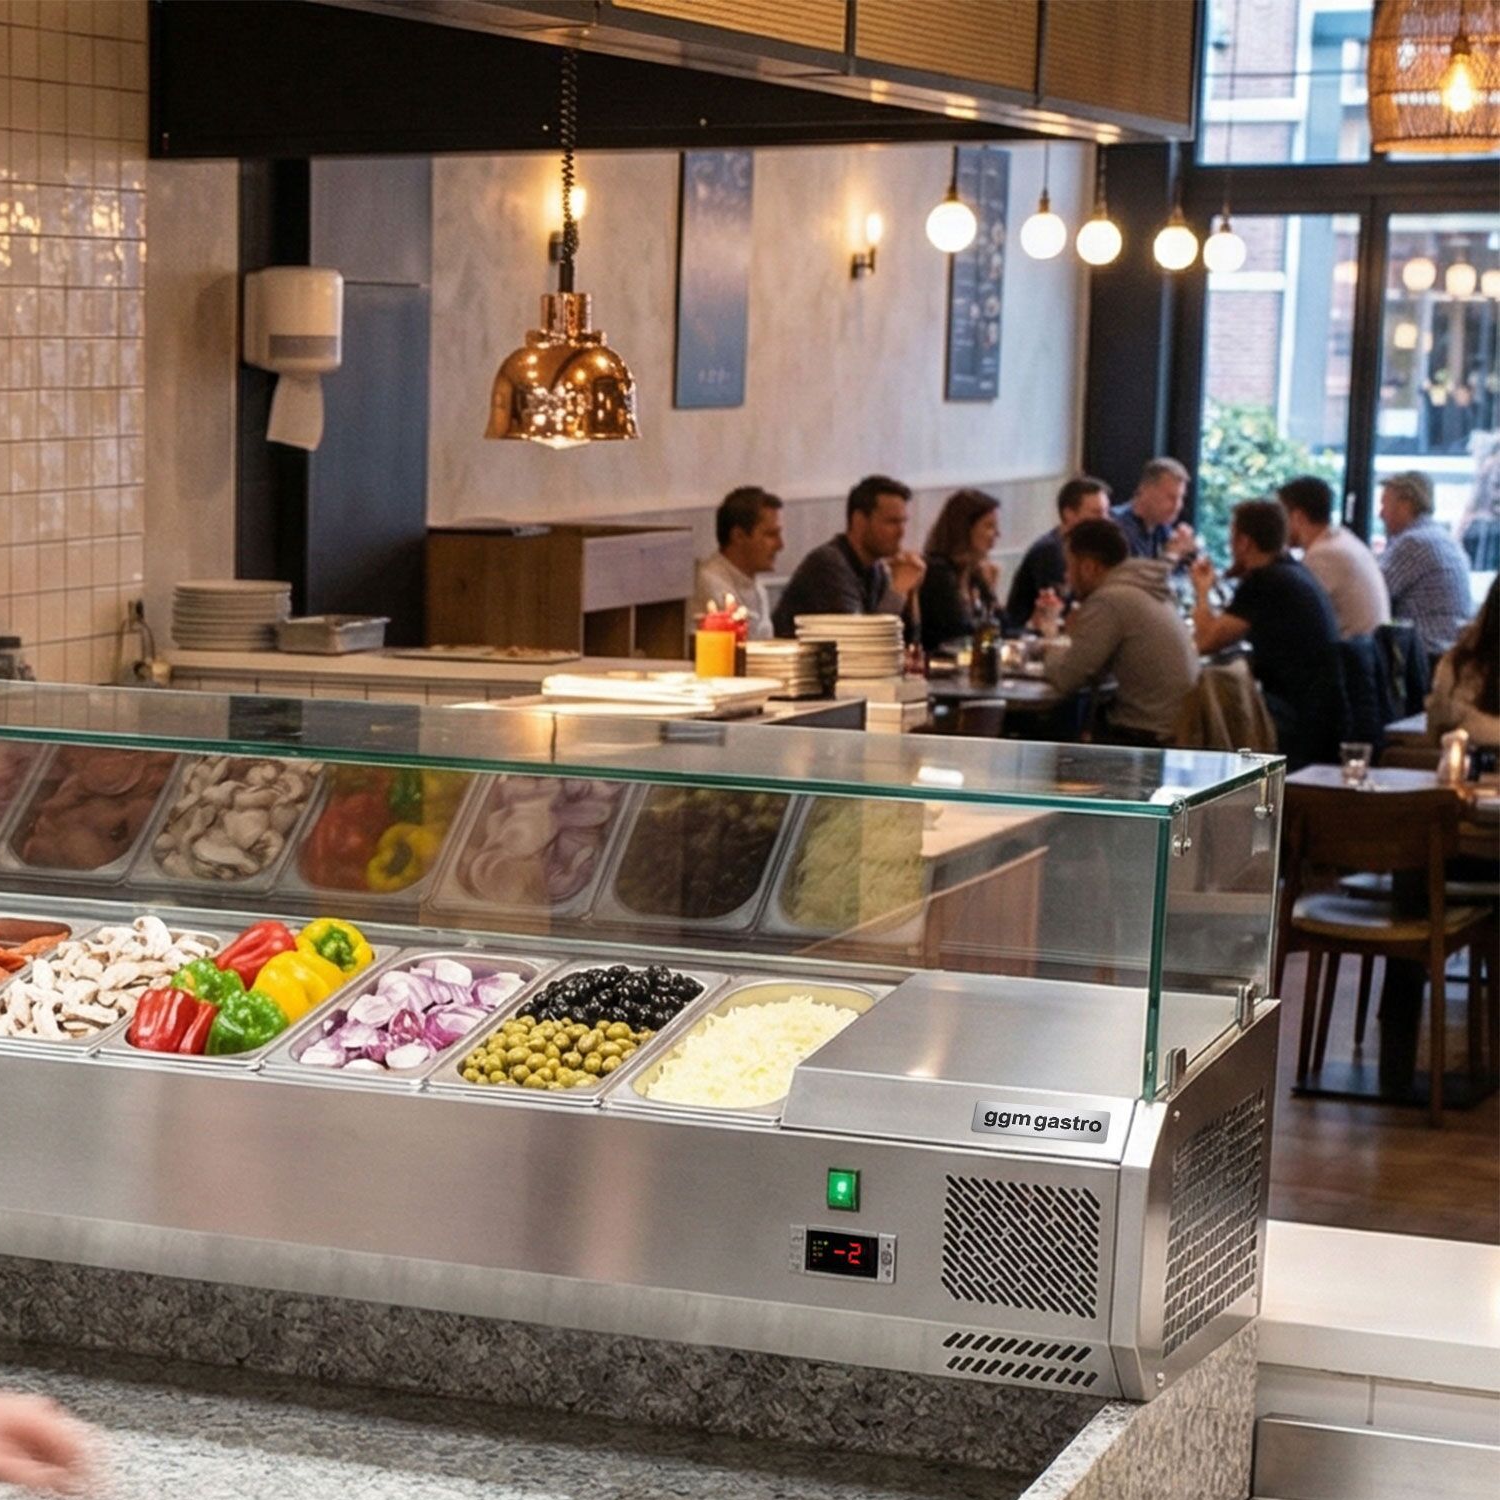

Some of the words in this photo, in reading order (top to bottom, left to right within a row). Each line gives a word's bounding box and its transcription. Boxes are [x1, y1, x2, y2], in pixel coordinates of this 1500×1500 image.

[984, 1111, 1031, 1128] ggm
[1033, 1115, 1102, 1132] gastro
[833, 1242, 862, 1265] -2
